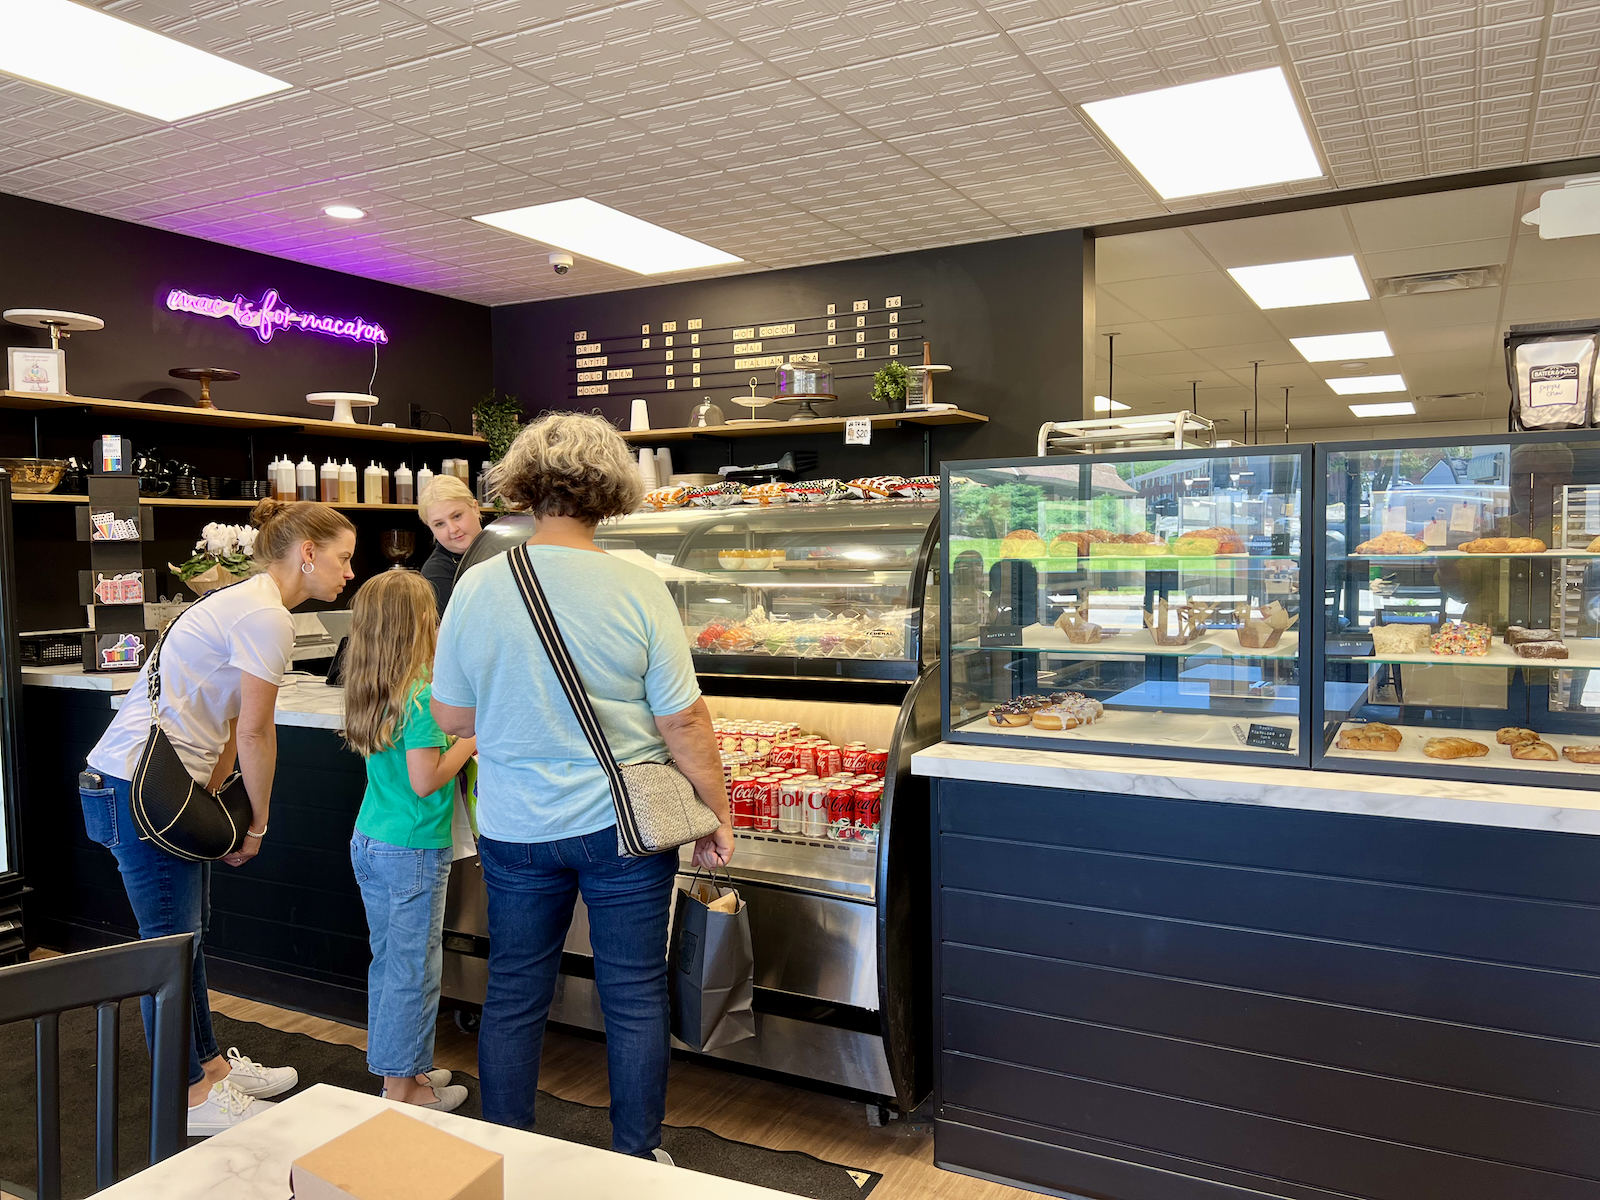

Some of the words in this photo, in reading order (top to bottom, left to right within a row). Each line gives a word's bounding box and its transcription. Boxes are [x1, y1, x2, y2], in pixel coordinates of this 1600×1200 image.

[855, 302, 867, 310] 12
[887, 298, 900, 306] 16
[168, 289, 229, 314] mac
[234, 297, 258, 324] is
[259, 290, 296, 340] for
[299, 313, 387, 342] macaron
[575, 332, 586, 340] OZ
[664, 323, 675, 331] 12
[734, 329, 754, 339] HOT
[760, 325, 795, 336] COCOA
[891, 314, 896, 322] 6
[576, 344, 600, 354] DRIP
[735, 343, 761, 353] CHAI
[829, 336, 835, 344] 4
[858, 333, 863, 341] 5
[577, 357, 607, 367] LATTE
[736, 356, 783, 368] ITALIAN
[858, 349, 864, 357] 4
[891, 346, 896, 354] 5
[578, 372, 602, 381] COLD
[607, 370, 632, 379] BREW
[577, 385, 608, 395] MOCHA
